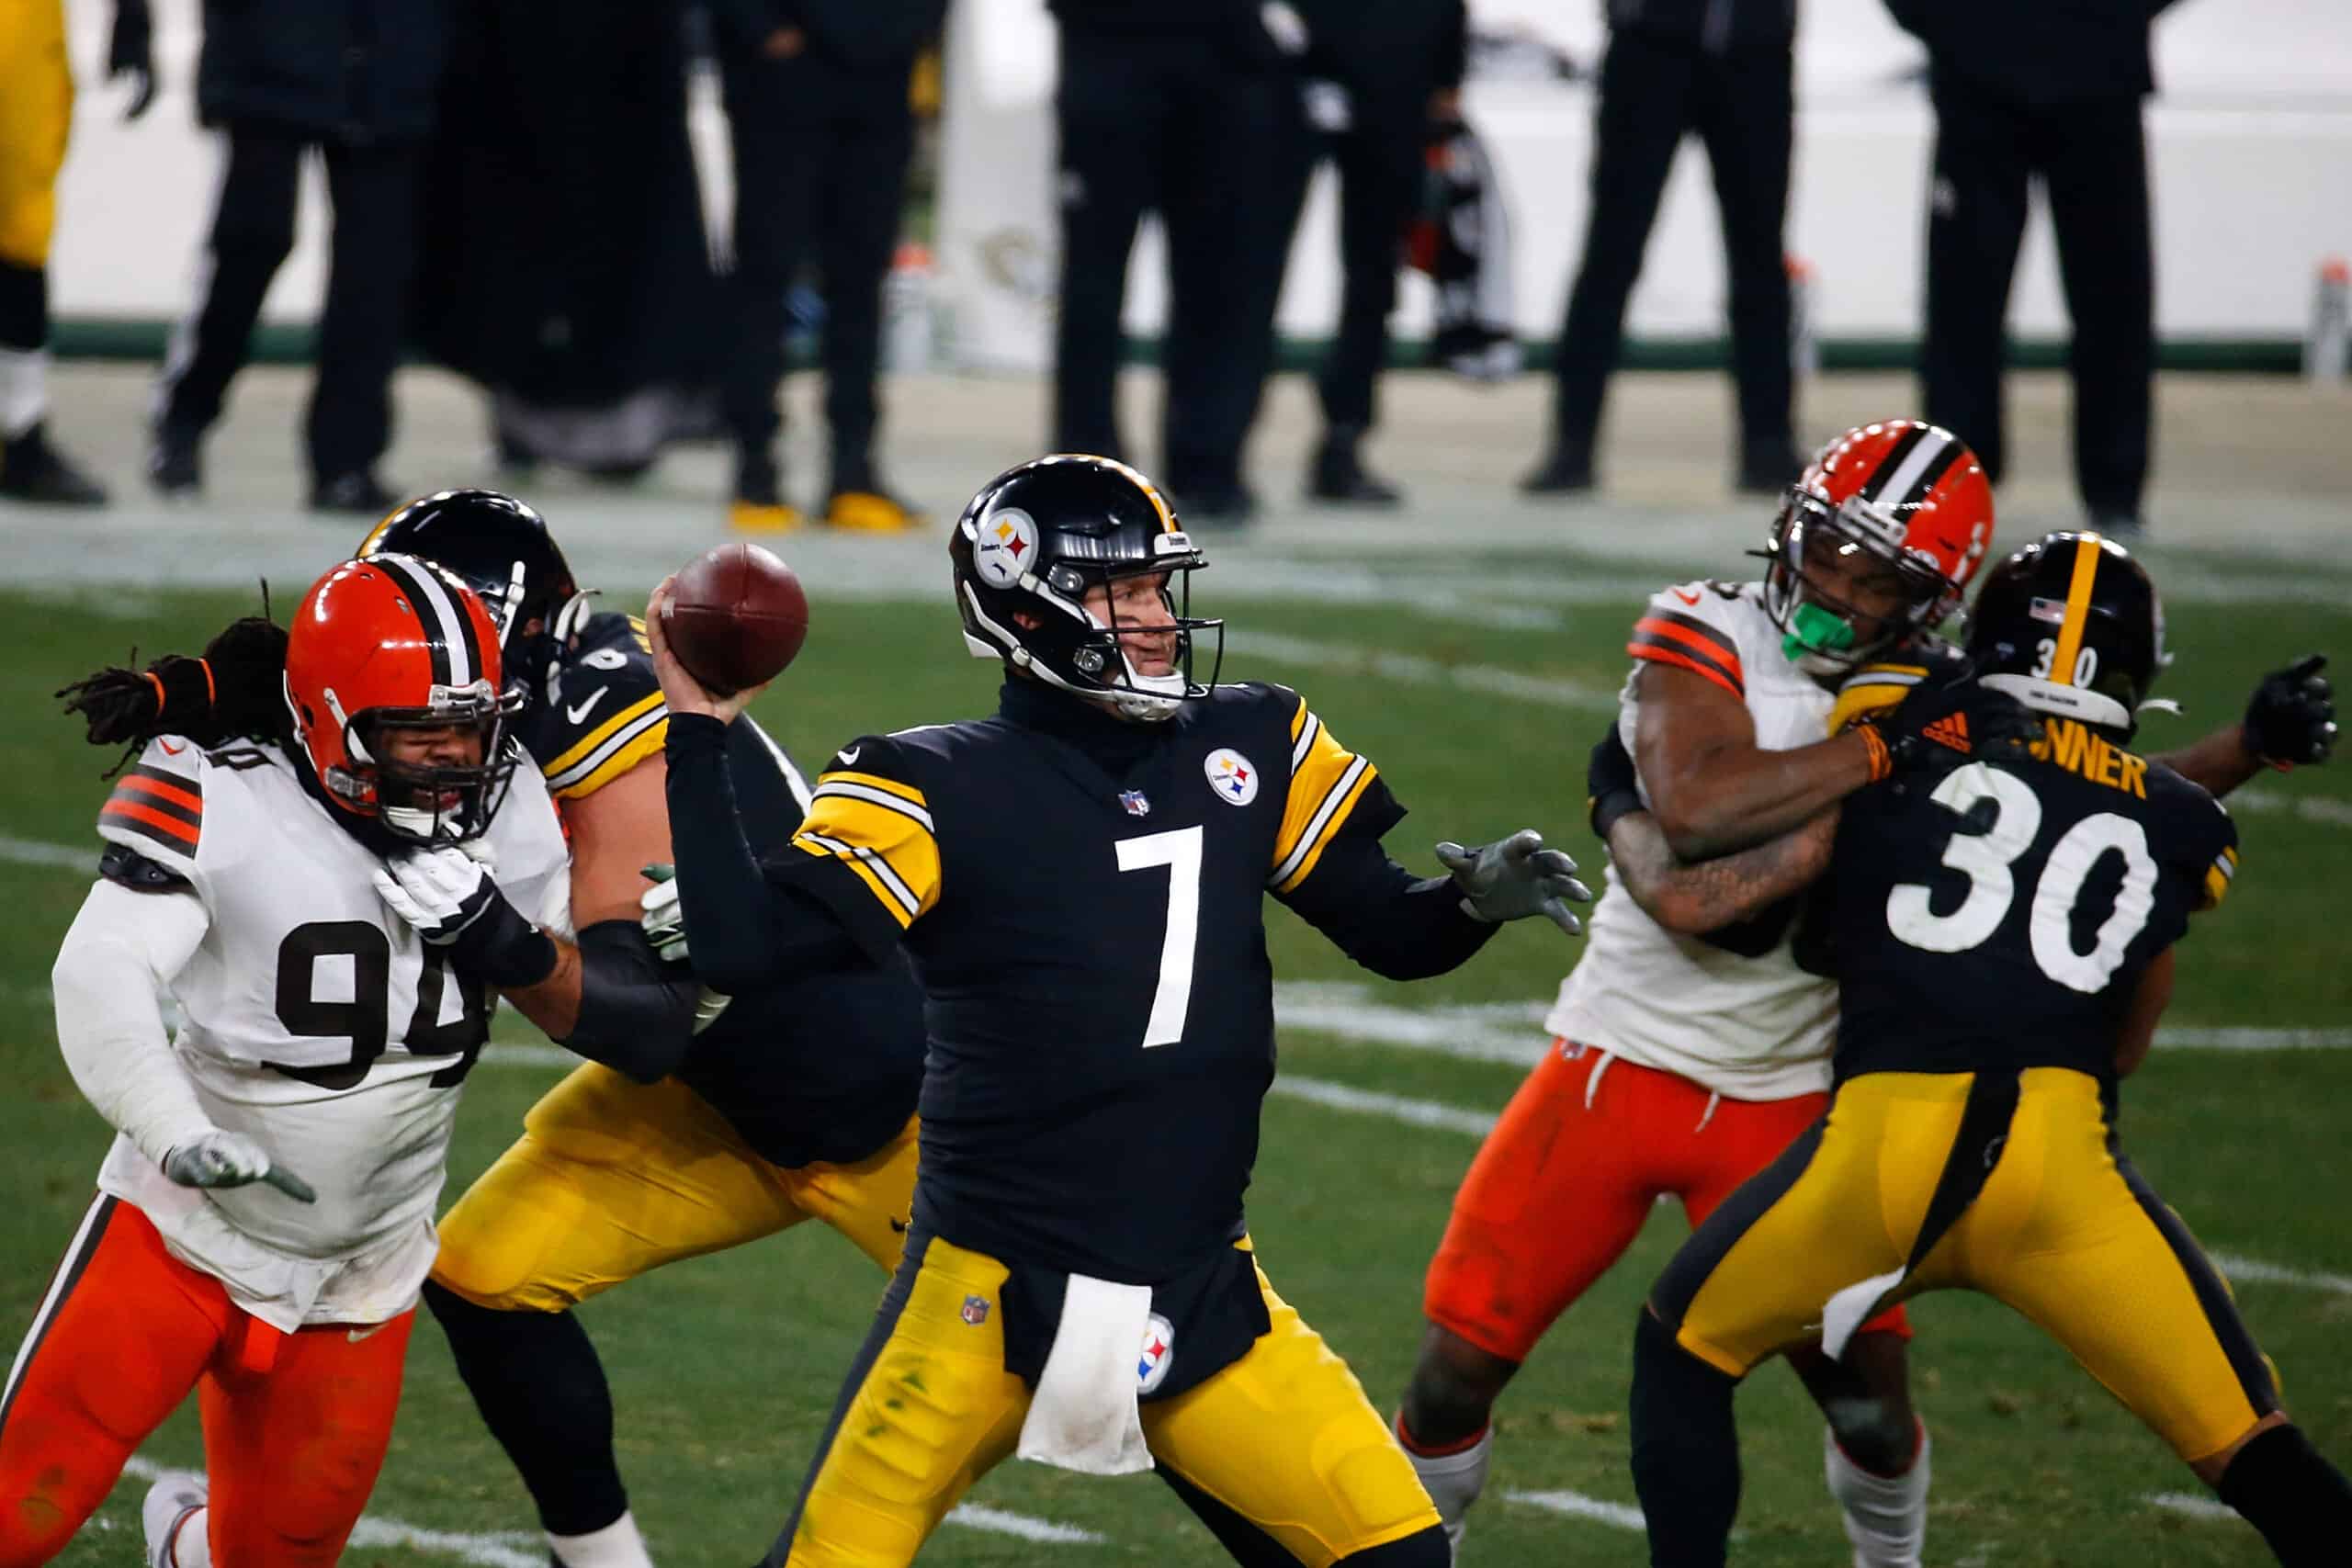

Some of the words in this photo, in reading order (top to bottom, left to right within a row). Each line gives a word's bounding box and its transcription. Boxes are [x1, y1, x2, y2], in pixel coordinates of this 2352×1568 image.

[2030, 637, 2098, 689] 30
[1114, 824, 1204, 1049] 7
[1886, 761, 2159, 994] 30
[260, 919, 491, 1091] 94
